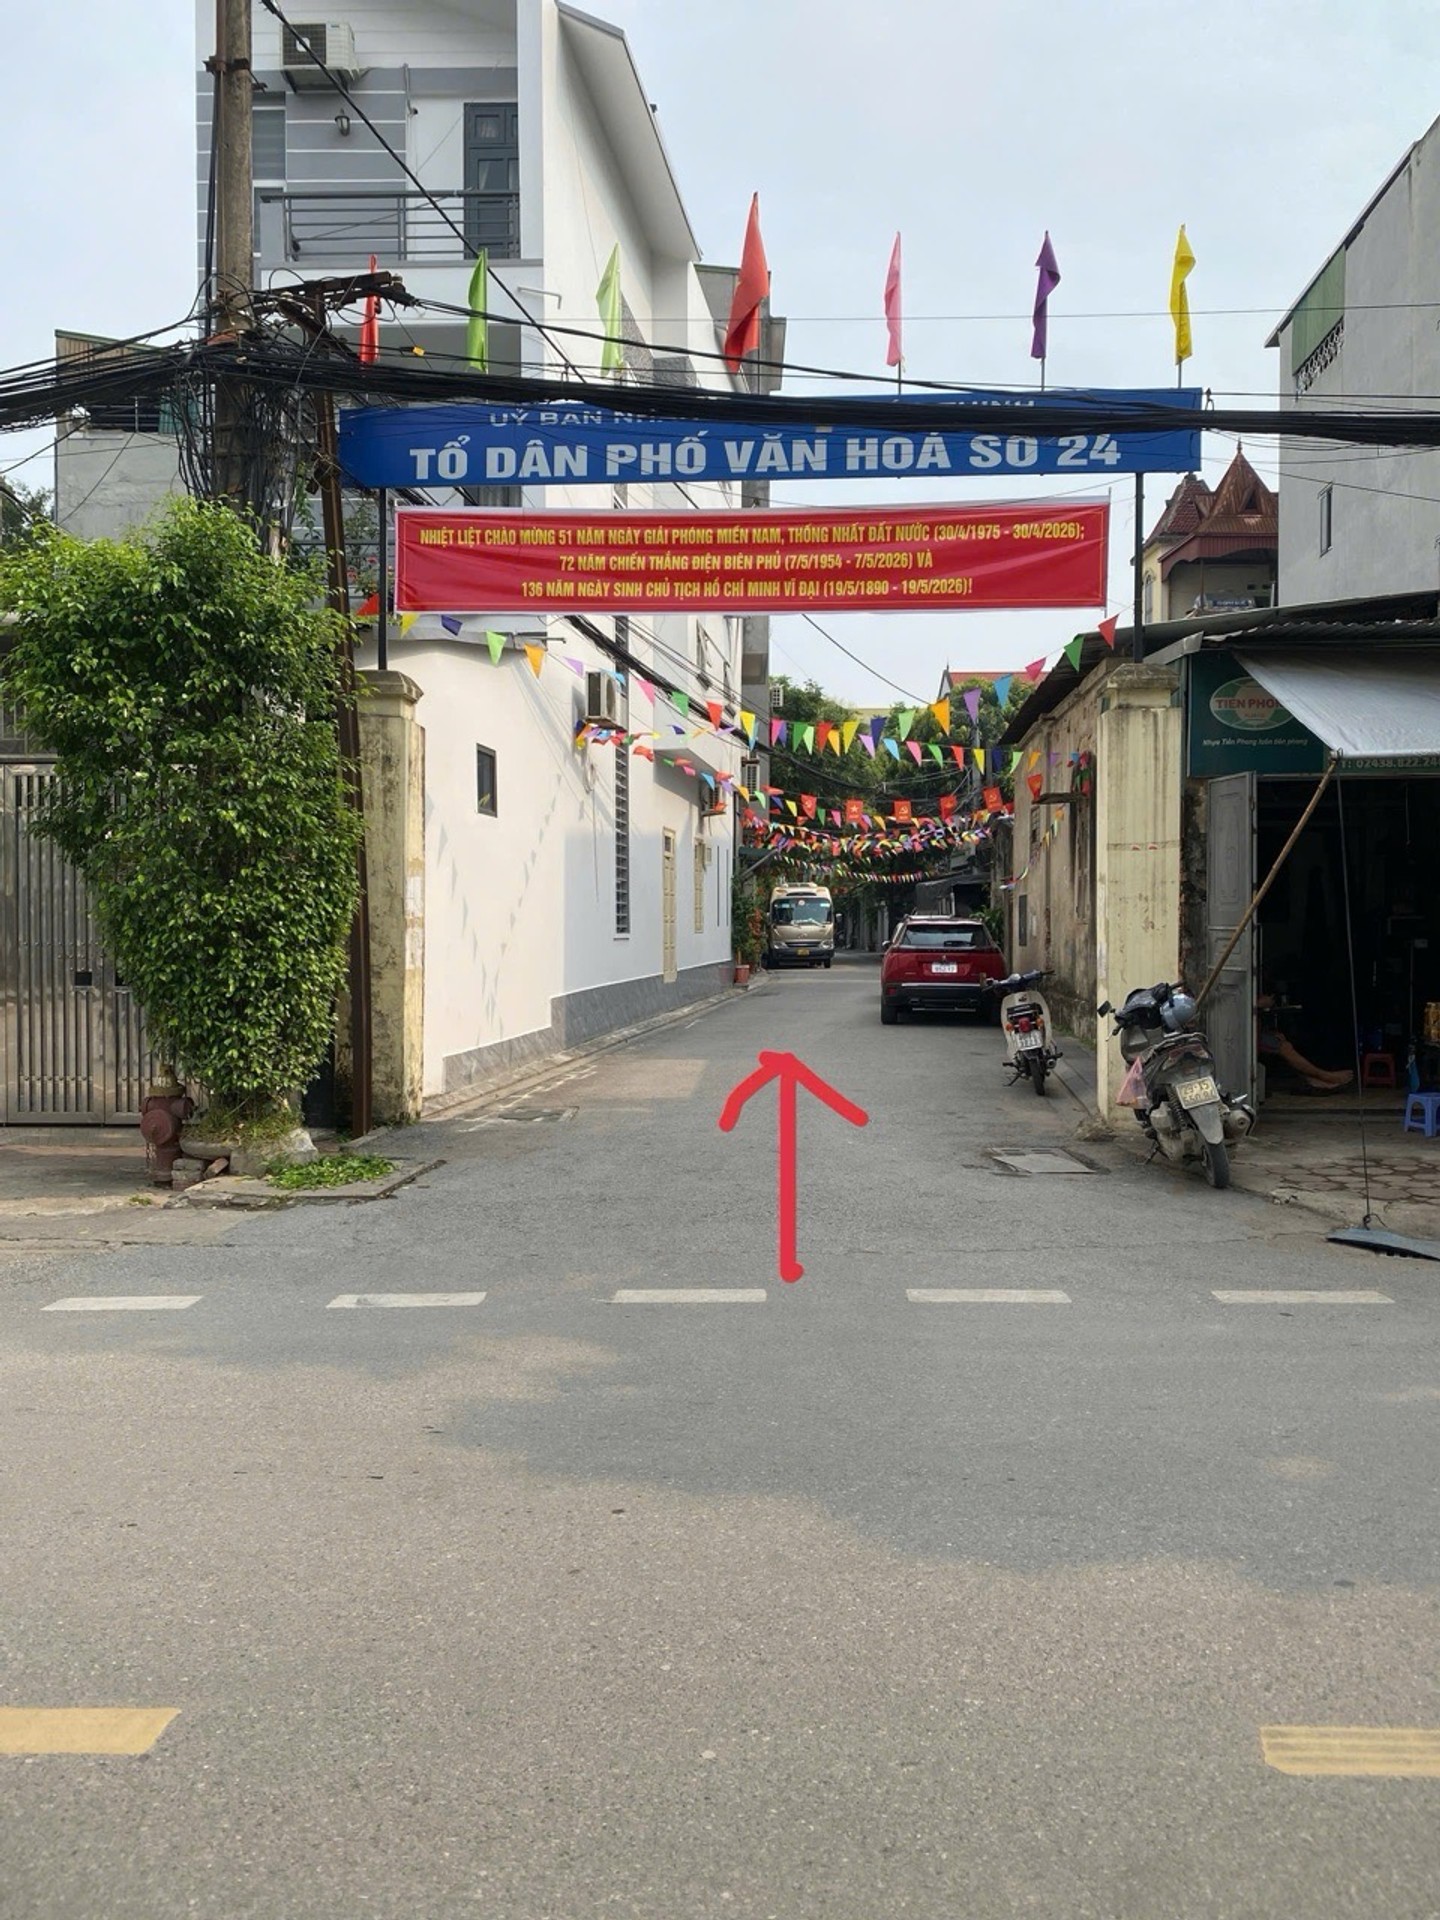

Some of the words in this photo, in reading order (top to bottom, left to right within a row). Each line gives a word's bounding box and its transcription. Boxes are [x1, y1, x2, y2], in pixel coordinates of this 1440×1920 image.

[540, 411, 602, 426] BAN
[409, 435, 471, 480] TỔ
[486, 439, 588, 479] DÂN
[606, 430, 708, 476] PHỐ
[724, 433, 828, 474] VĂN
[1056, 434, 1122, 467] 24
[420, 526, 454, 548] NHIỆT
[458, 526, 481, 548] LIỆT
[485, 526, 516, 545] CHÀO
[520, 526, 555, 545] MỪNG
[559, 529, 572, 545] 51
[576, 526, 605, 544] NĂM
[608, 526, 640, 545] NGÀY
[644, 525, 668, 545] GIẢI
[672, 526, 713, 544] PHÓNG
[752, 528, 784, 545] NAM,
[788, 523, 828, 543] THỐNG
[833, 521, 864, 543] NHẤT
[868, 521, 892, 542] ĐẤT
[895, 520, 929, 541] NƯỚC
[934, 524, 1000, 542] (30/4/1975
[1013, 522, 1085, 540] 30/4/2026);
[560, 556, 575, 571] 72
[578, 553, 605, 571] NĂM
[609, 551, 646, 571] CHIẾN
[649, 551, 688, 570] THẮNG
[692, 552, 721, 574] ĐIỆN
[724, 552, 753, 570] BIÊN
[756, 550, 781, 570] PHỦ
[785, 553, 842, 571] (7/5/1954
[854, 552, 913, 569] 7/5/2026)
[917, 549, 933, 569] VÀ
[522, 582, 543, 597] 136
[546, 579, 574, 597] NĂM
[577, 579, 610, 597] NGÀY
[613, 582, 642, 597] SINH
[646, 577, 670, 597] CHỦ
[674, 582, 700, 600] TỊCH
[723, 578, 744, 597] CHÍ
[747, 581, 780, 597] MINH
[784, 578, 796, 597] VĨ
[799, 581, 820, 600] ĐẠI
[823, 580, 889, 597] (19/5/1890
[902, 578, 972, 596] 19/5/2026)!
